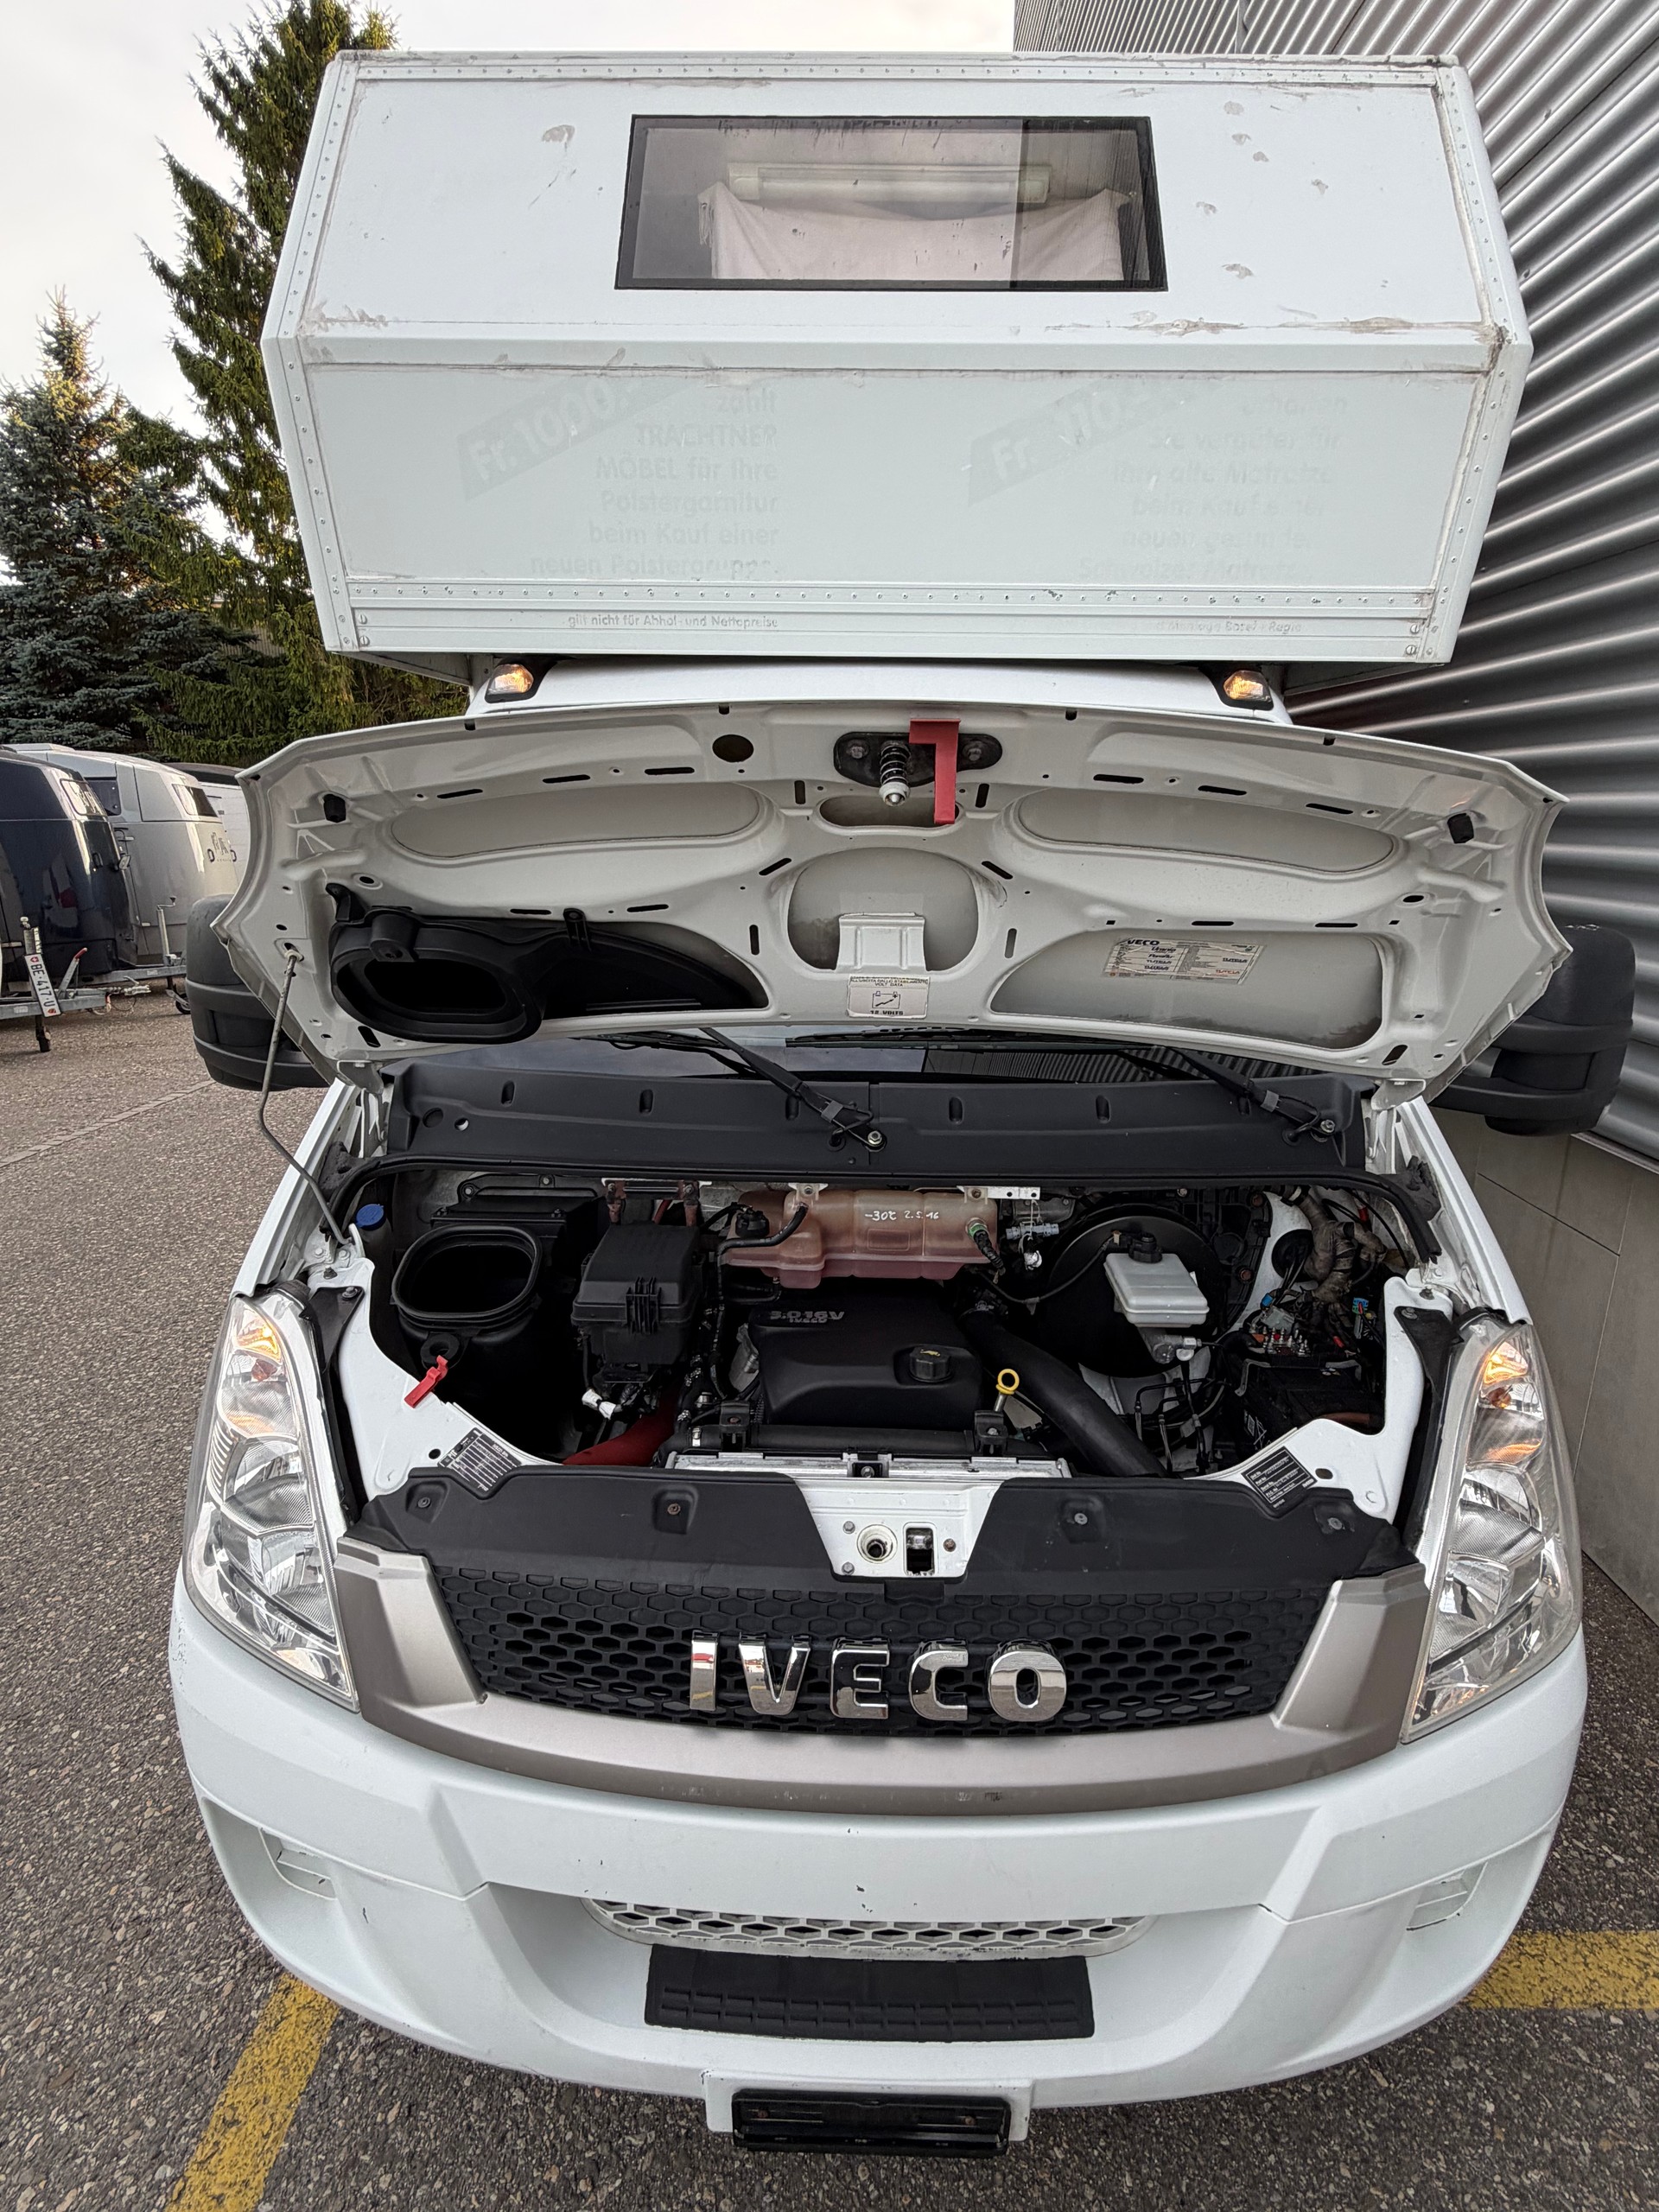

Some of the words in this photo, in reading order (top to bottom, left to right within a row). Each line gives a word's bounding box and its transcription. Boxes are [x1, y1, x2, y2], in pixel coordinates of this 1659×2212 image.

[635, 423, 779, 448] TRACHTNER
[468, 439, 518, 481] Fr.
[596, 452, 678, 480] MÖBEL
[687, 455, 722, 480] für
[601, 489, 779, 518] Polstergarnitur
[588, 520, 646, 544] beim
[656, 522, 709, 545] Kauf
[718, 524, 780, 546] einer
[530, 556, 601, 575] neuen
[591, 614, 620, 626] nicht
[622, 614, 640, 626] für
[689, 1630, 1069, 1723] IVECO
